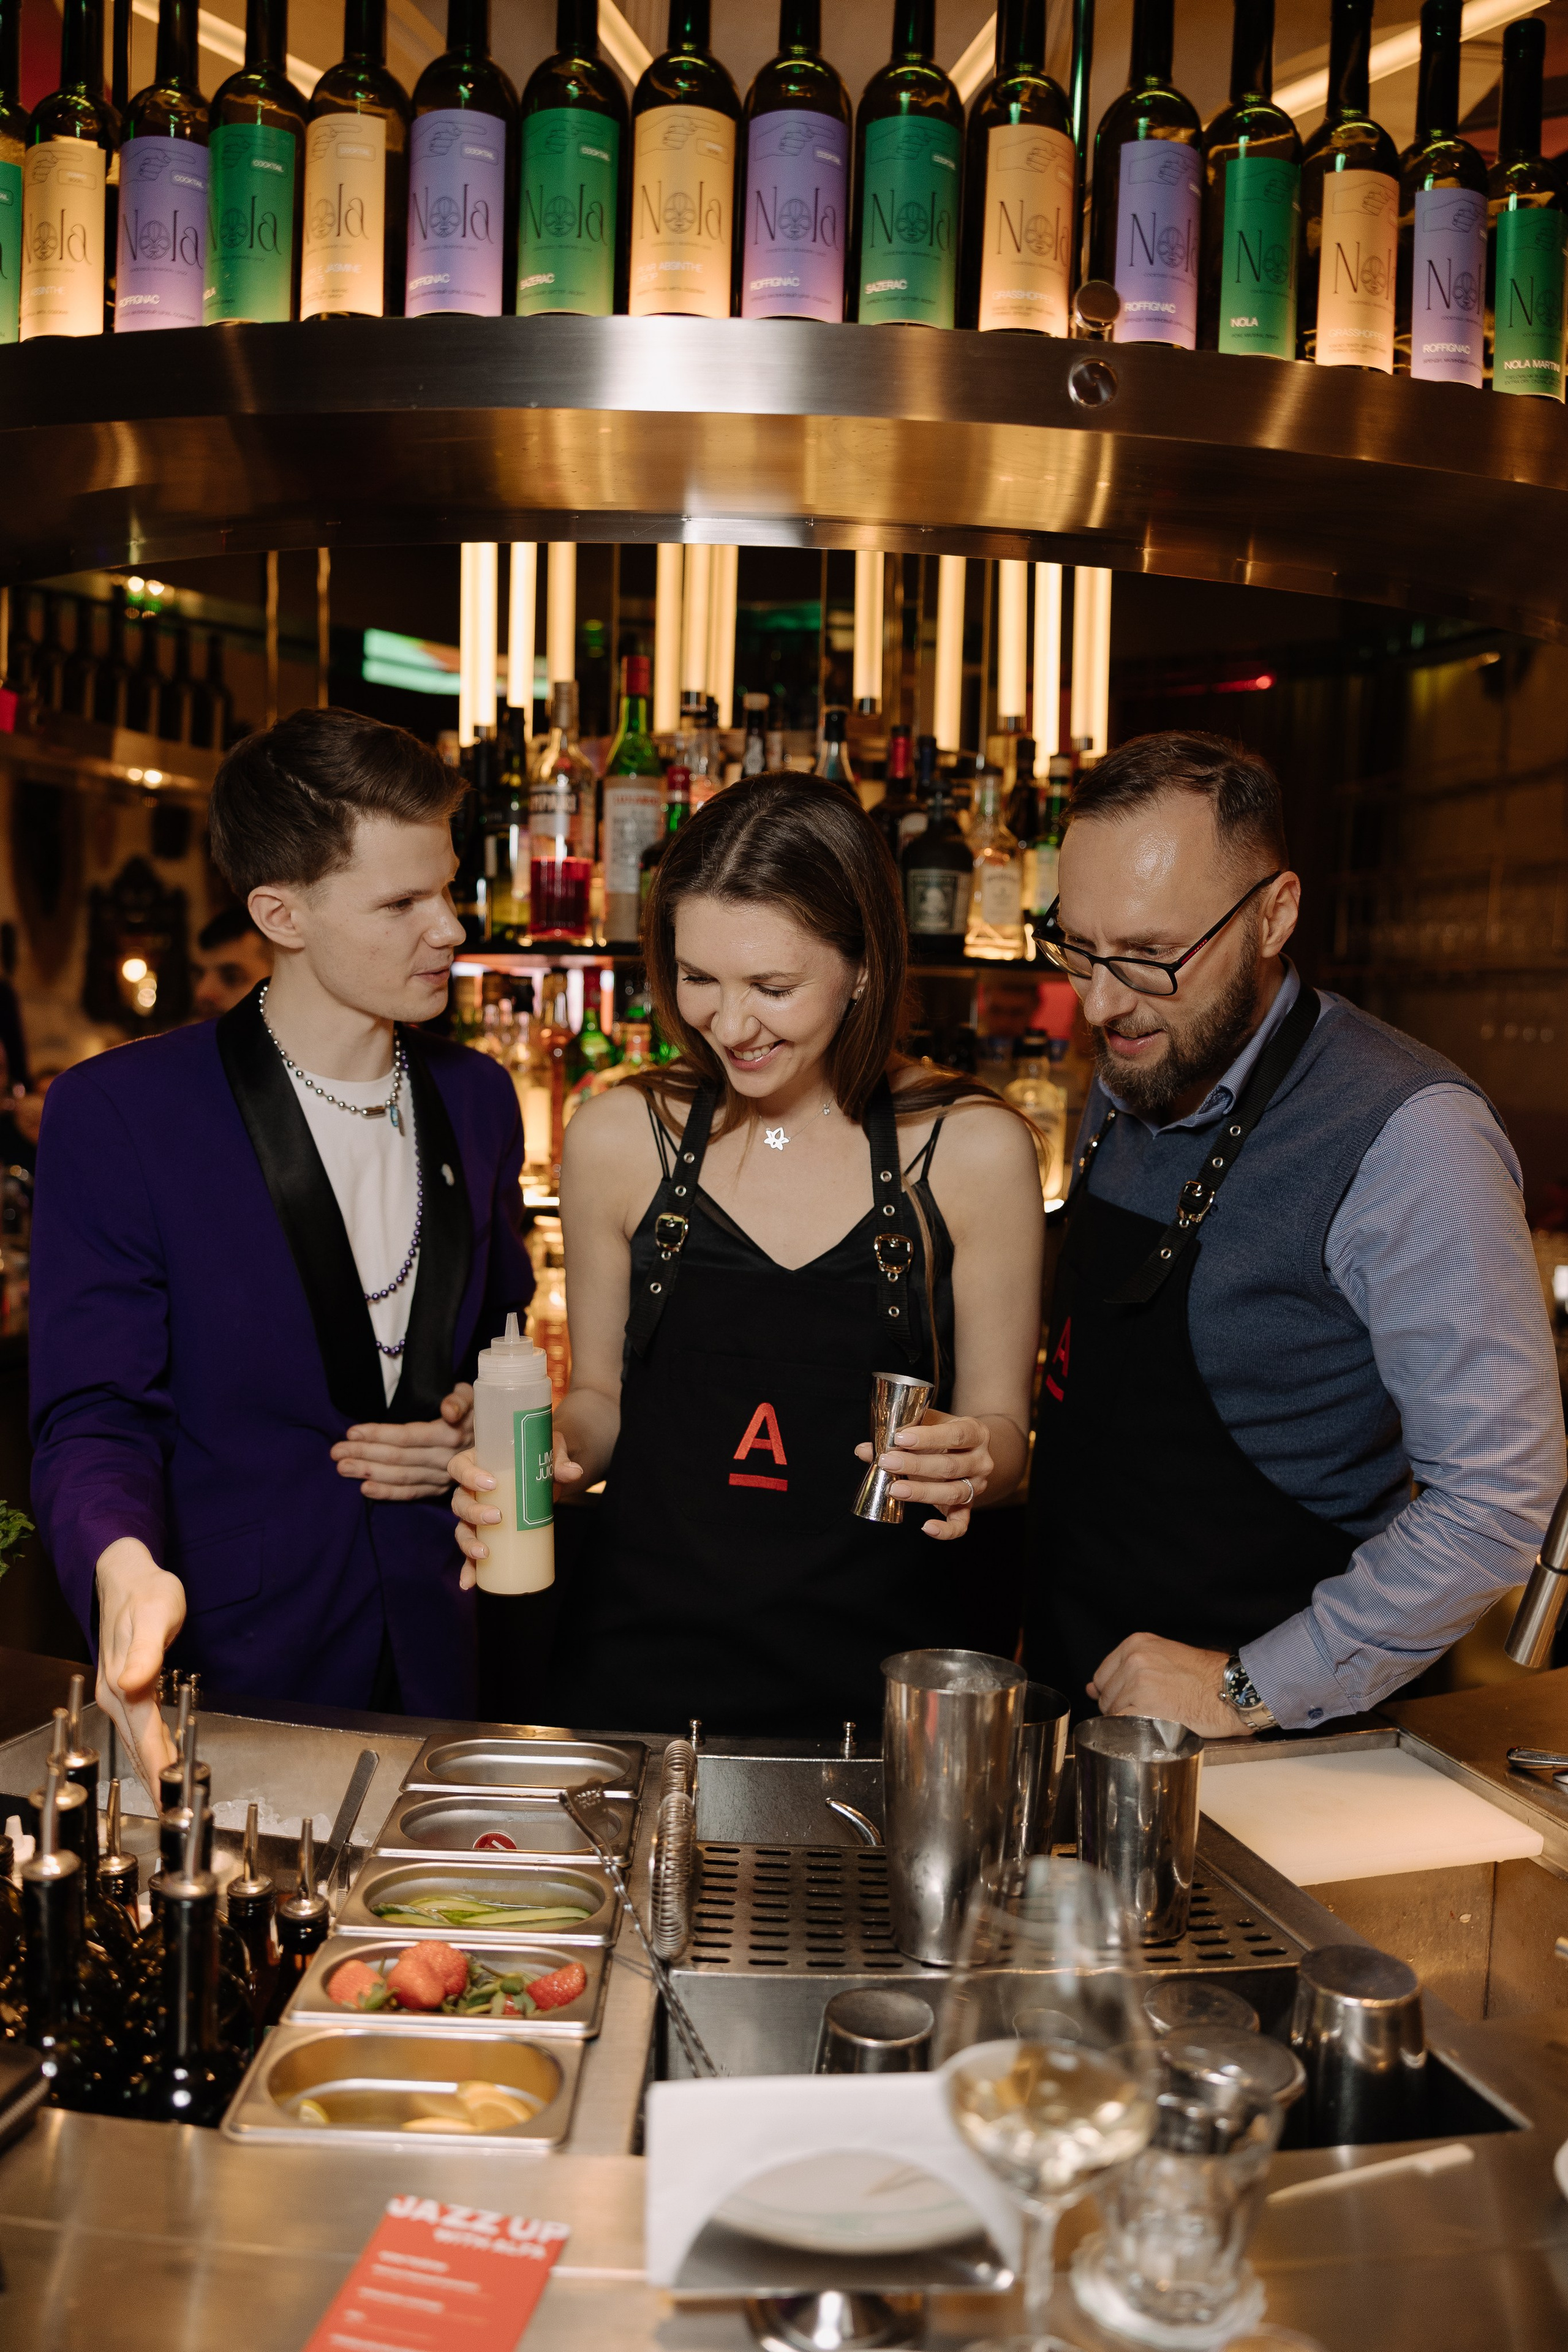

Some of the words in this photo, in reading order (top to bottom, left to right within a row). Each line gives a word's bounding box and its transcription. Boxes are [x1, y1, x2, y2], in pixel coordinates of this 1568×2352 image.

[410, 183, 494, 247] Nola
[524, 184, 608, 246] Nola
[639, 181, 726, 244] Nola
[754, 186, 839, 251] Nola
[870, 189, 951, 252] Nola
[750, 276, 800, 292] ROFFIGNAC
[864, 278, 908, 295] SAZERAC
[992, 290, 1055, 304] GRASSHOPPER
[1124, 301, 1177, 314] ROFFIGNAC
[1230, 316, 1259, 328] NOLA
[1328, 328, 1387, 343] GRASSHOPPER
[1422, 343, 1471, 355] ROFFIGNAC
[1504, 360, 1531, 371] NOLA
[733, 1403, 788, 1465] A
[386, 2194, 503, 2236] JAZZ
[507, 2215, 571, 2244] UP
